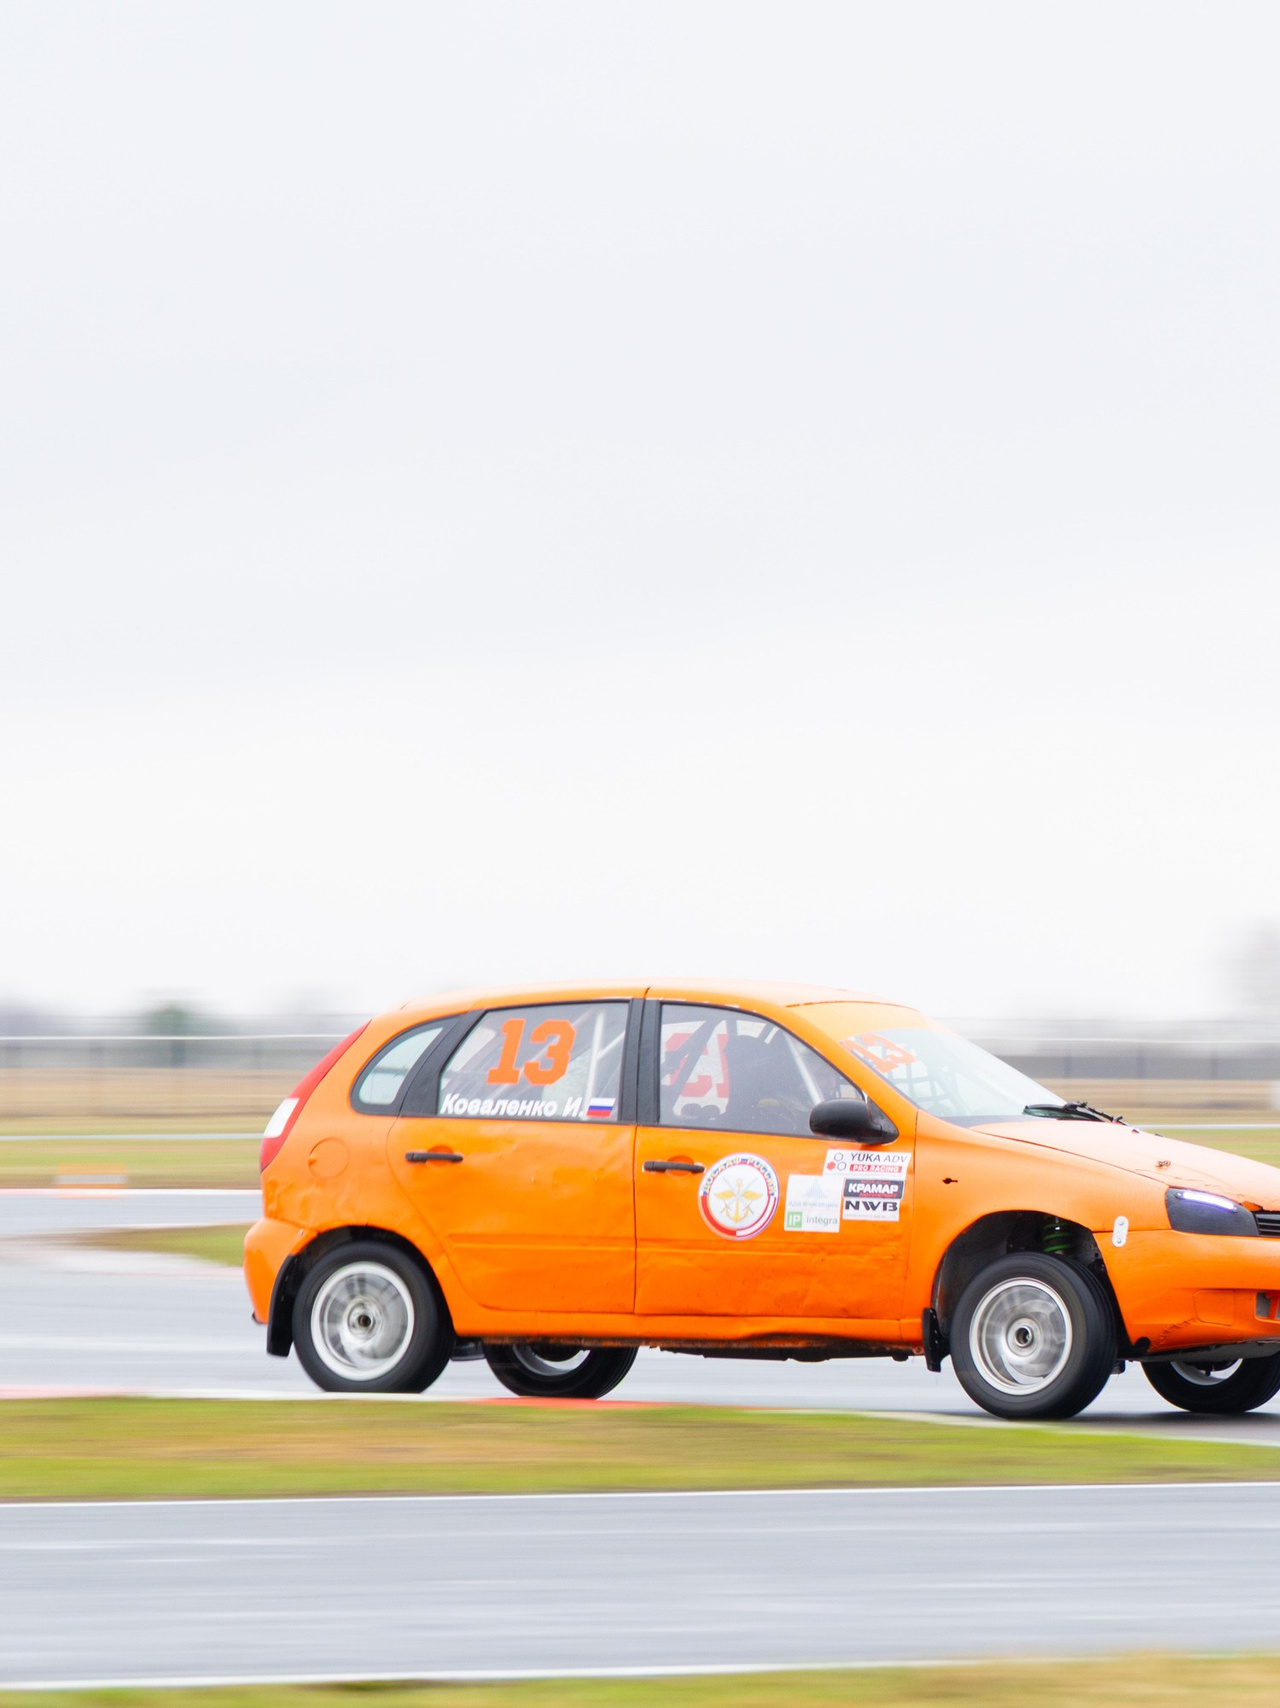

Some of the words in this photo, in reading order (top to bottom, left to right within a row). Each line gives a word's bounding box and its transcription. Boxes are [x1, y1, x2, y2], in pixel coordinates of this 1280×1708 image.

[486, 1018, 577, 1085] 13
[440, 1093, 558, 1117] Коваленко
[850, 1153, 881, 1162] YUKA
[883, 1154, 908, 1163] ADV
[853, 1164, 868, 1172] PRO
[870, 1165, 900, 1173] RACING
[848, 1183, 899, 1194] КРАМАР
[845, 1200, 898, 1212] NWB
[806, 1215, 838, 1227] integra
